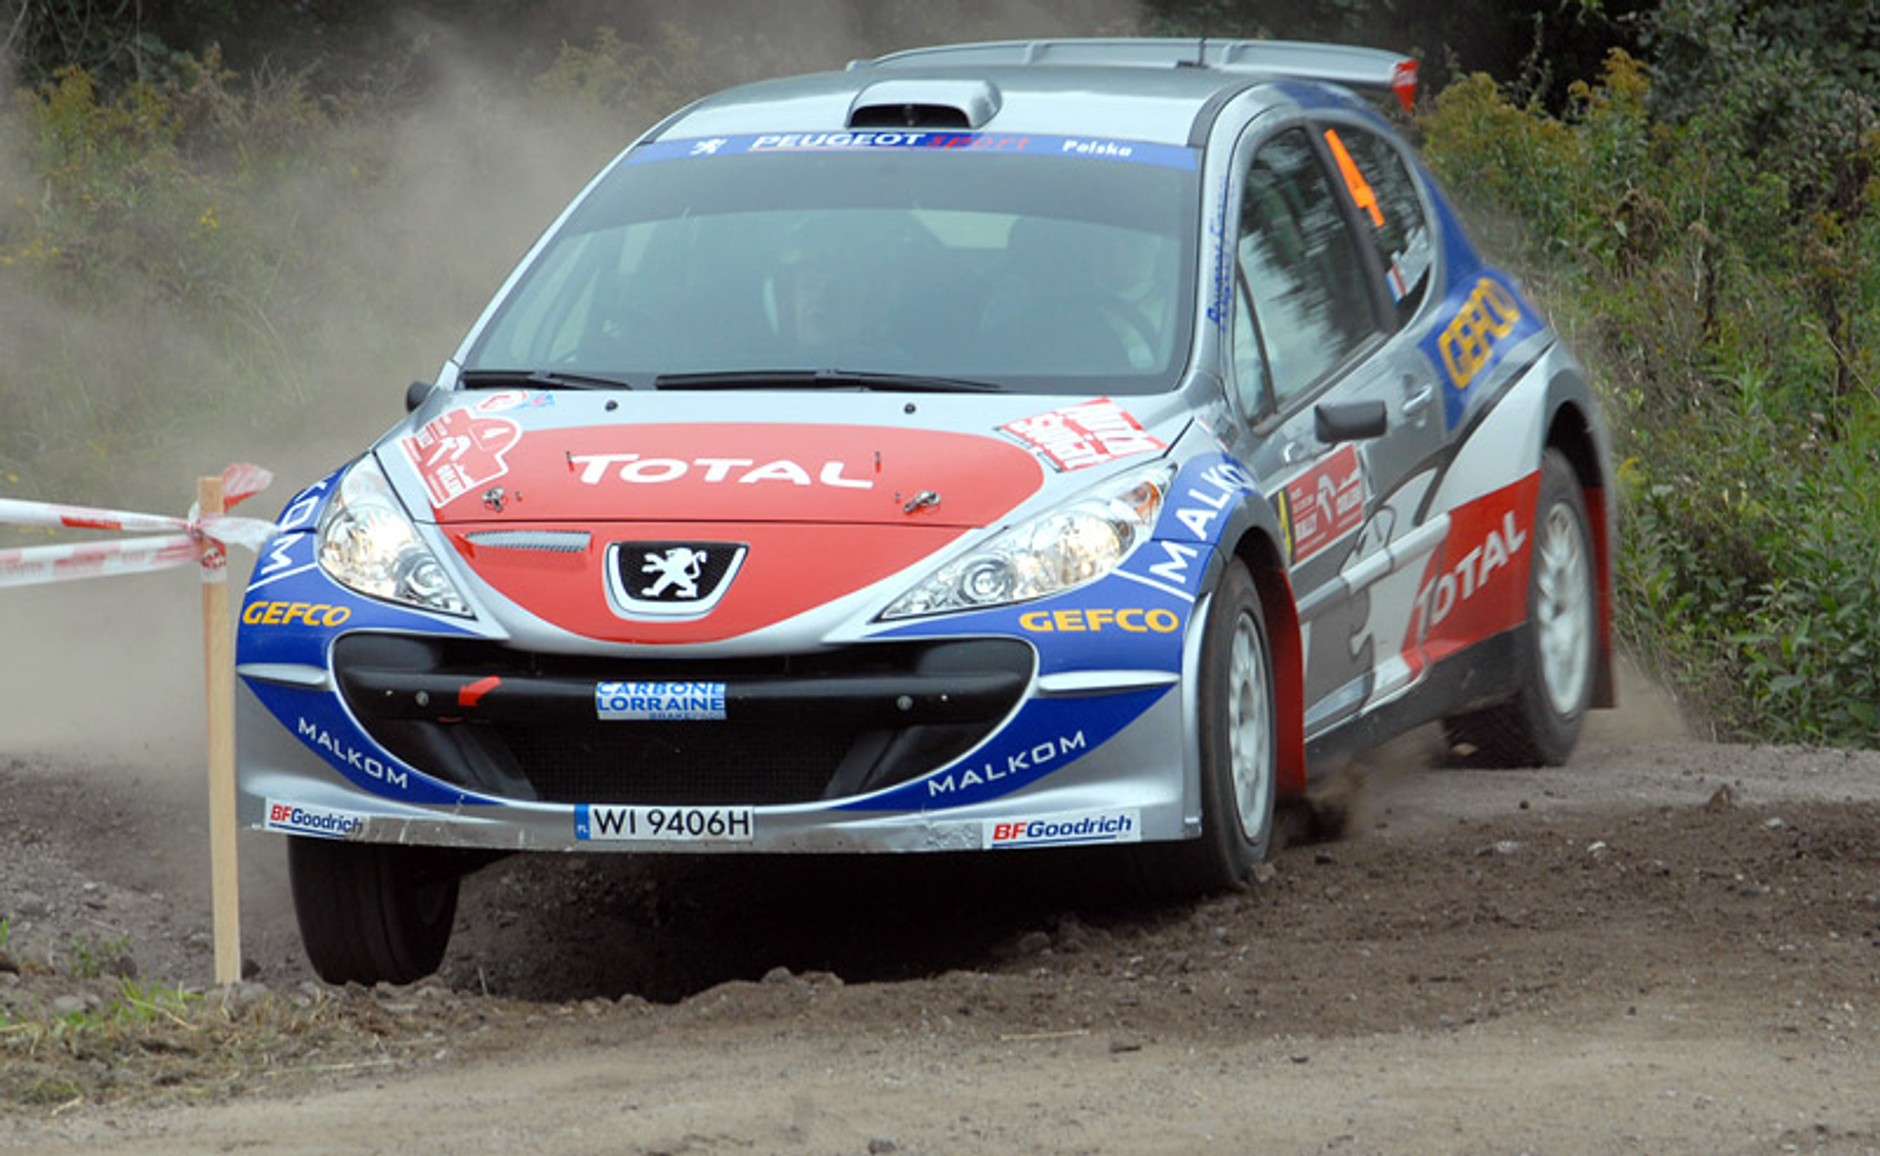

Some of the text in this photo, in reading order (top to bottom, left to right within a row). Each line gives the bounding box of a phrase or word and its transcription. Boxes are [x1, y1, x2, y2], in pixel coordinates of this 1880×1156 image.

[751, 133, 1133, 157] PEUGEOT sport Polska
[570, 453, 874, 490] TOTAL
[1415, 510, 1527, 632] TOTAL
[243, 601, 352, 627] GEFCO
[1019, 608, 1180, 633] GEFCO
[597, 682, 727, 696] CARBONE
[597, 697, 726, 711] LORRAINE
[298, 716, 409, 790] MALKOM
[927, 730, 1087, 797] MALKOM
[270, 804, 363, 834] BFGoodrich
[594, 808, 750, 836] WI 9406H
[992, 815, 1133, 841] BFGoodrich
